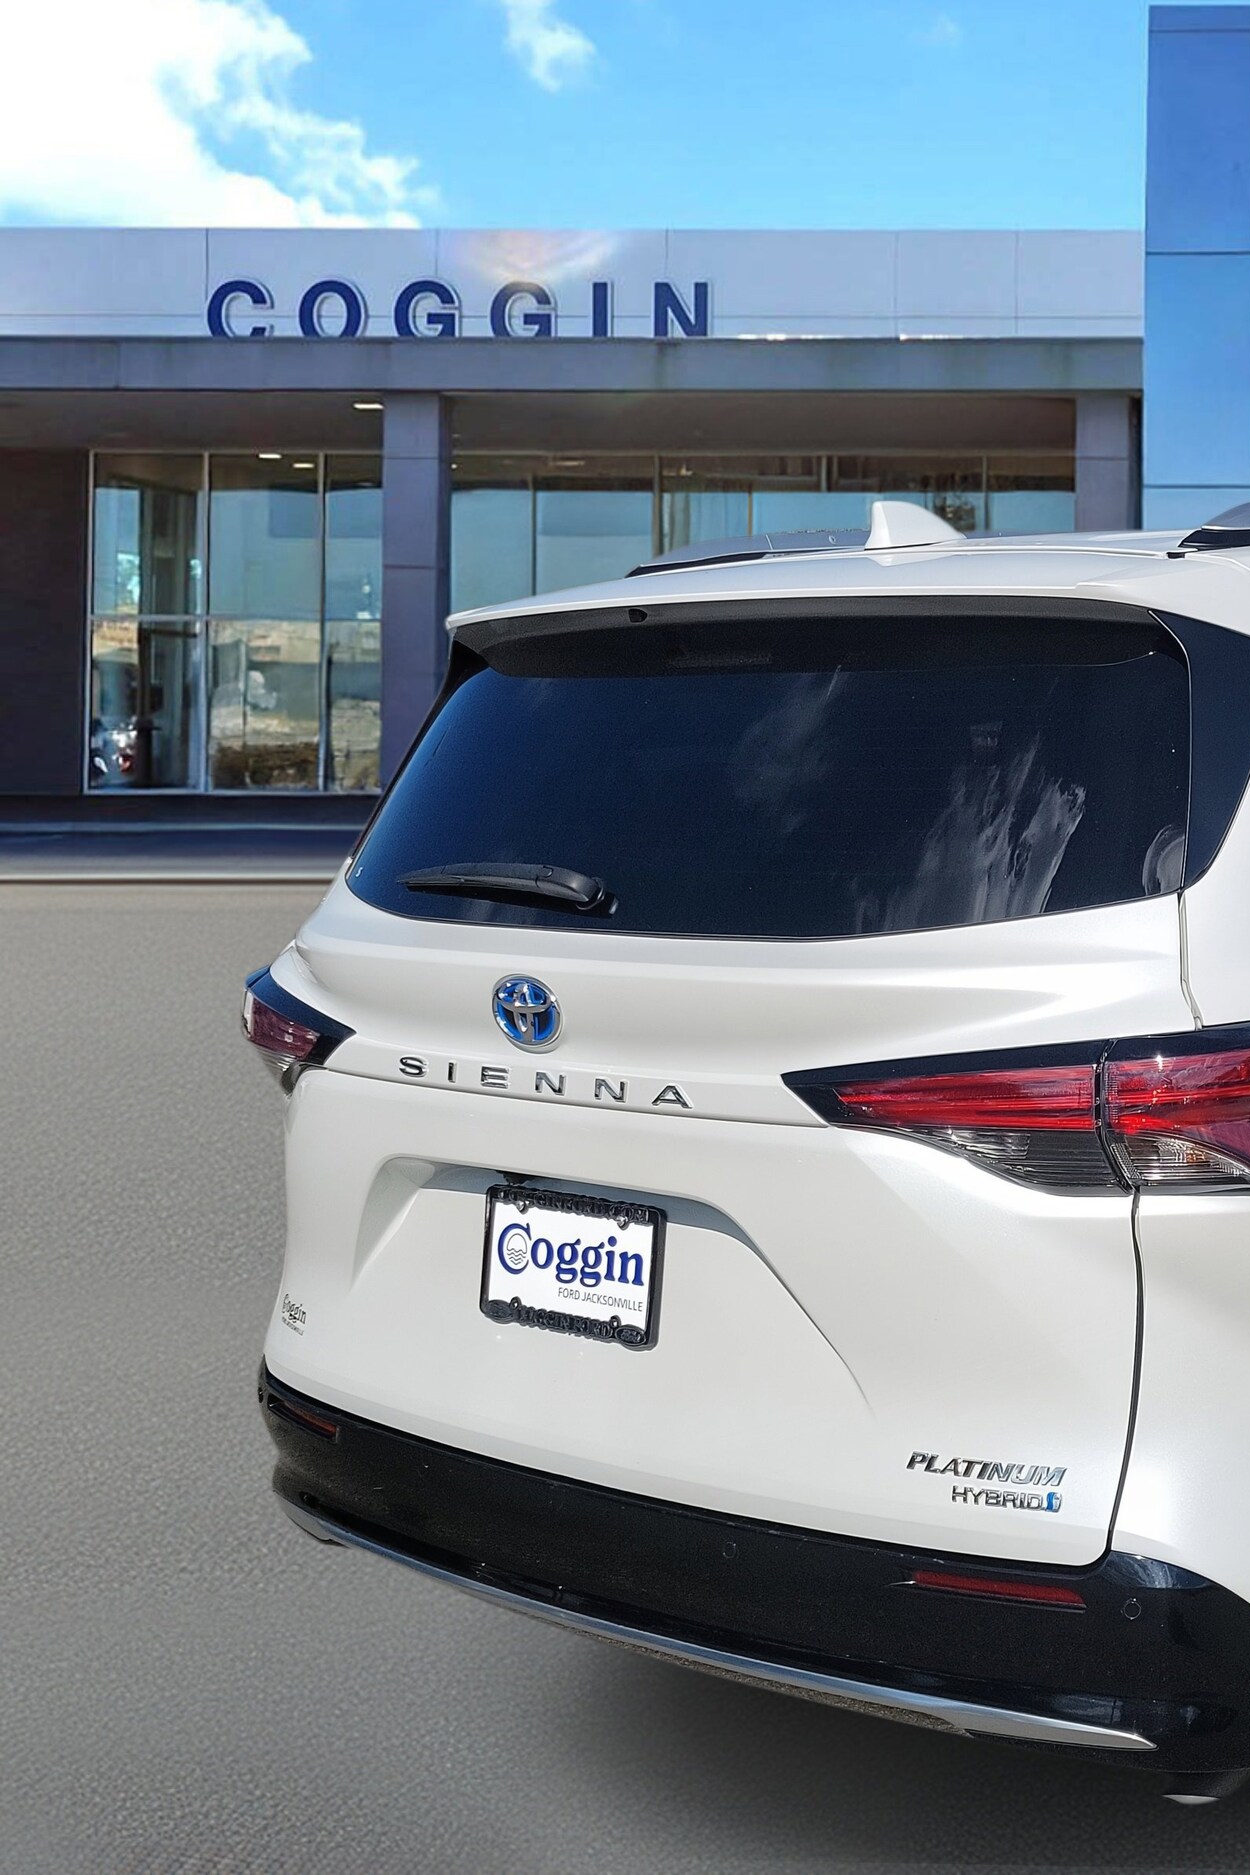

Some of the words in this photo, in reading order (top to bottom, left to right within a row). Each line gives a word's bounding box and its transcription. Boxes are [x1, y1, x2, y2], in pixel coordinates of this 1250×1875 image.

[206, 278, 713, 338] COGGIN
[398, 1055, 694, 1110] SIENNA
[497, 1222, 645, 1288] Coggin
[557, 1287, 580, 1300] FORD
[581, 1291, 644, 1312] JACKSONVILLE
[906, 1450, 1068, 1487] PLATINUM
[951, 1485, 1044, 1511] HYBRID
